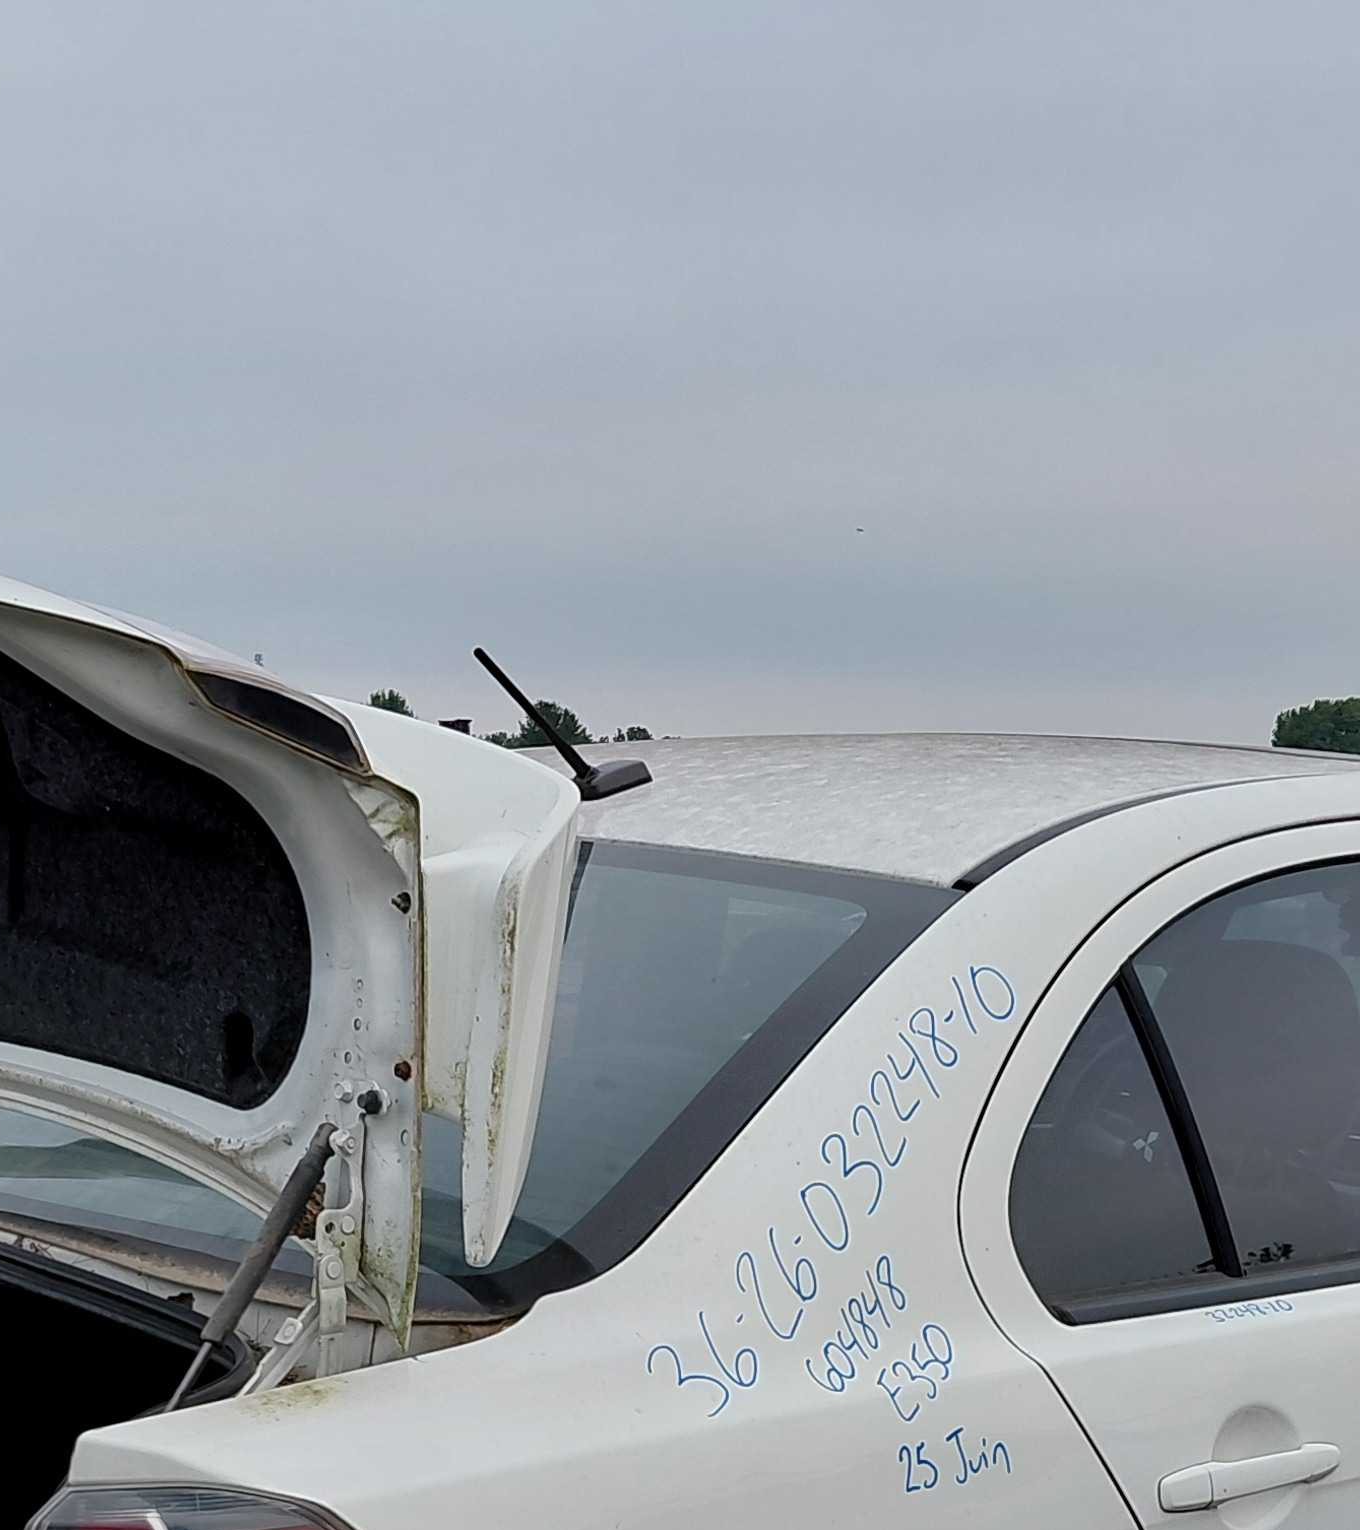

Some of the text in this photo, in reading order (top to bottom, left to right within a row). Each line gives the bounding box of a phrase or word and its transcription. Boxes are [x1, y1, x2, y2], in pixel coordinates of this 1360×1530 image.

[805, 1255, 907, 1394] 604848
[877, 1323, 954, 1422] E350
[897, 1426, 1012, 1493] 25 Juin
